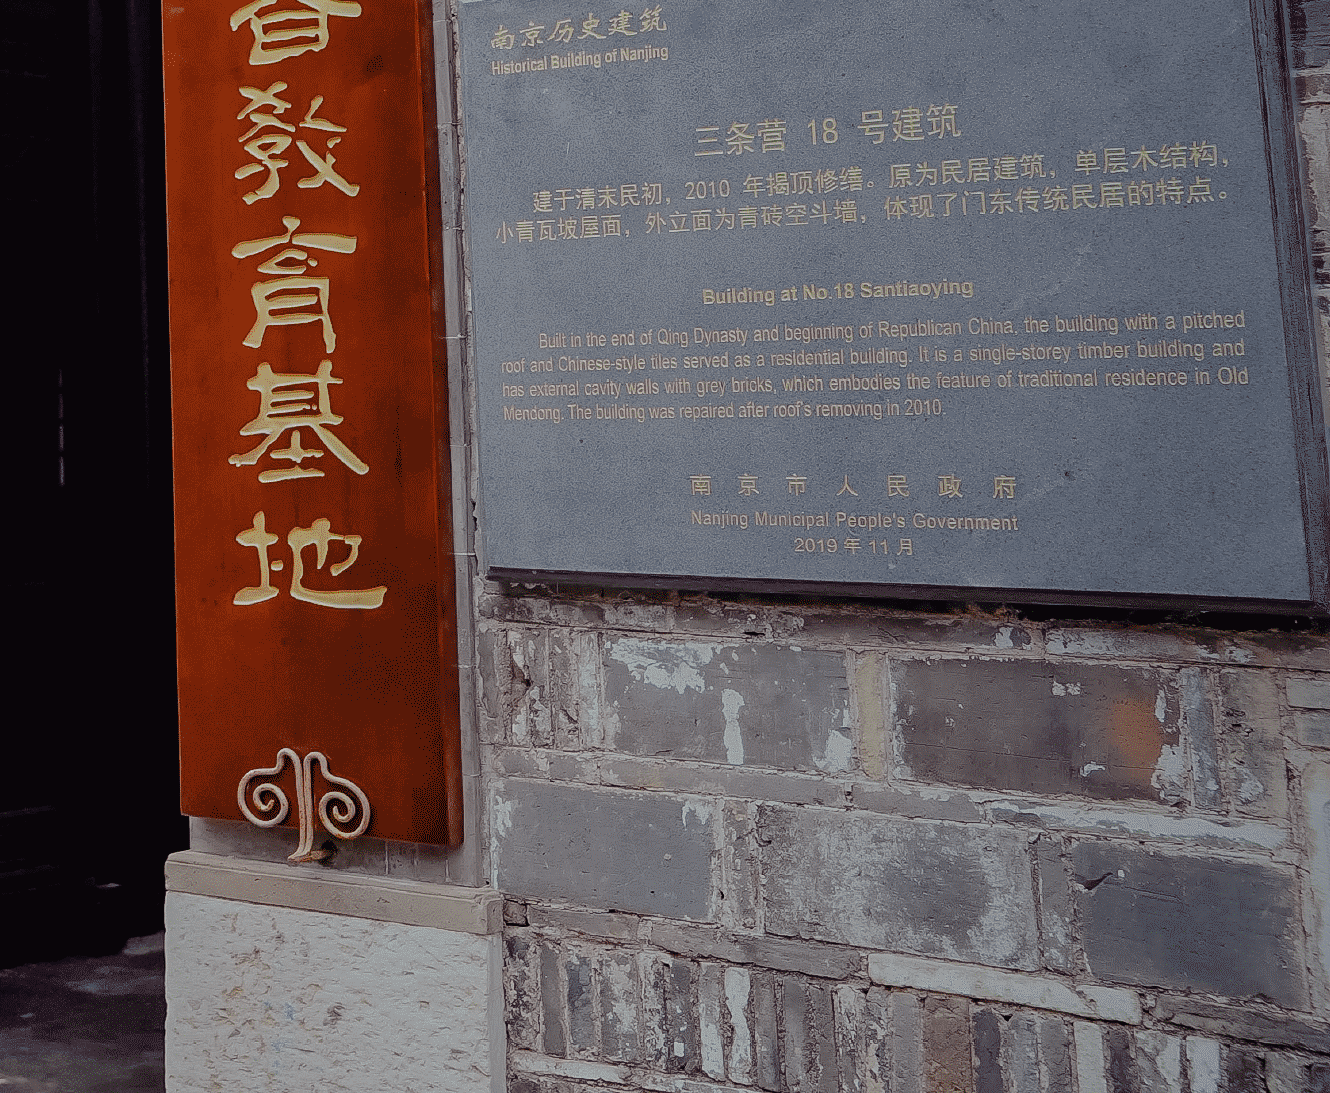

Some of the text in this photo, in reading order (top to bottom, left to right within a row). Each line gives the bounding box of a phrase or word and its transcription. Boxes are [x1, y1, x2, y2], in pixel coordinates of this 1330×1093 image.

[491, 4, 667, 50] 南京历史建筑
[492, 44, 669, 76] Historical Building of Nanjing
[694, 103, 962, 157] 三条营 18 号建筑
[702, 279, 973, 306] Building at No.18 Santiaoying
[539, 333, 566, 348] Built
[571, 332, 581, 347] in
[586, 332, 606, 347] the
[611, 330, 635, 346] end
[640, 329, 653, 345] of
[657, 328, 689, 347] Qing
[694, 327, 747, 346] Dynasty
[754, 325, 778, 341] and
[785, 323, 853, 344] beginning
[859, 322, 874, 338] of
[878, 319, 961, 340] Republican
[1024, 316, 1049, 333] the
[1055, 314, 1118, 335] building
[1124, 312, 1158, 330] with
[1165, 316, 1176, 329] a
[1183, 310, 1245, 333] pitched
[501, 338, 1245, 374] roof and Chinese-style tiles served as a residential building. It is a single-storey timber building and
[502, 366, 1249, 399] has external cavity walls with grey bricks, which embodies the feature of traditional residence in Old
[503, 399, 946, 423] Mendong. The building was repaired after roof's removing in 2010.
[690, 473, 1016, 499] 南京市人民政府
[691, 510, 1018, 532] Nanjing Municipal People's Government
